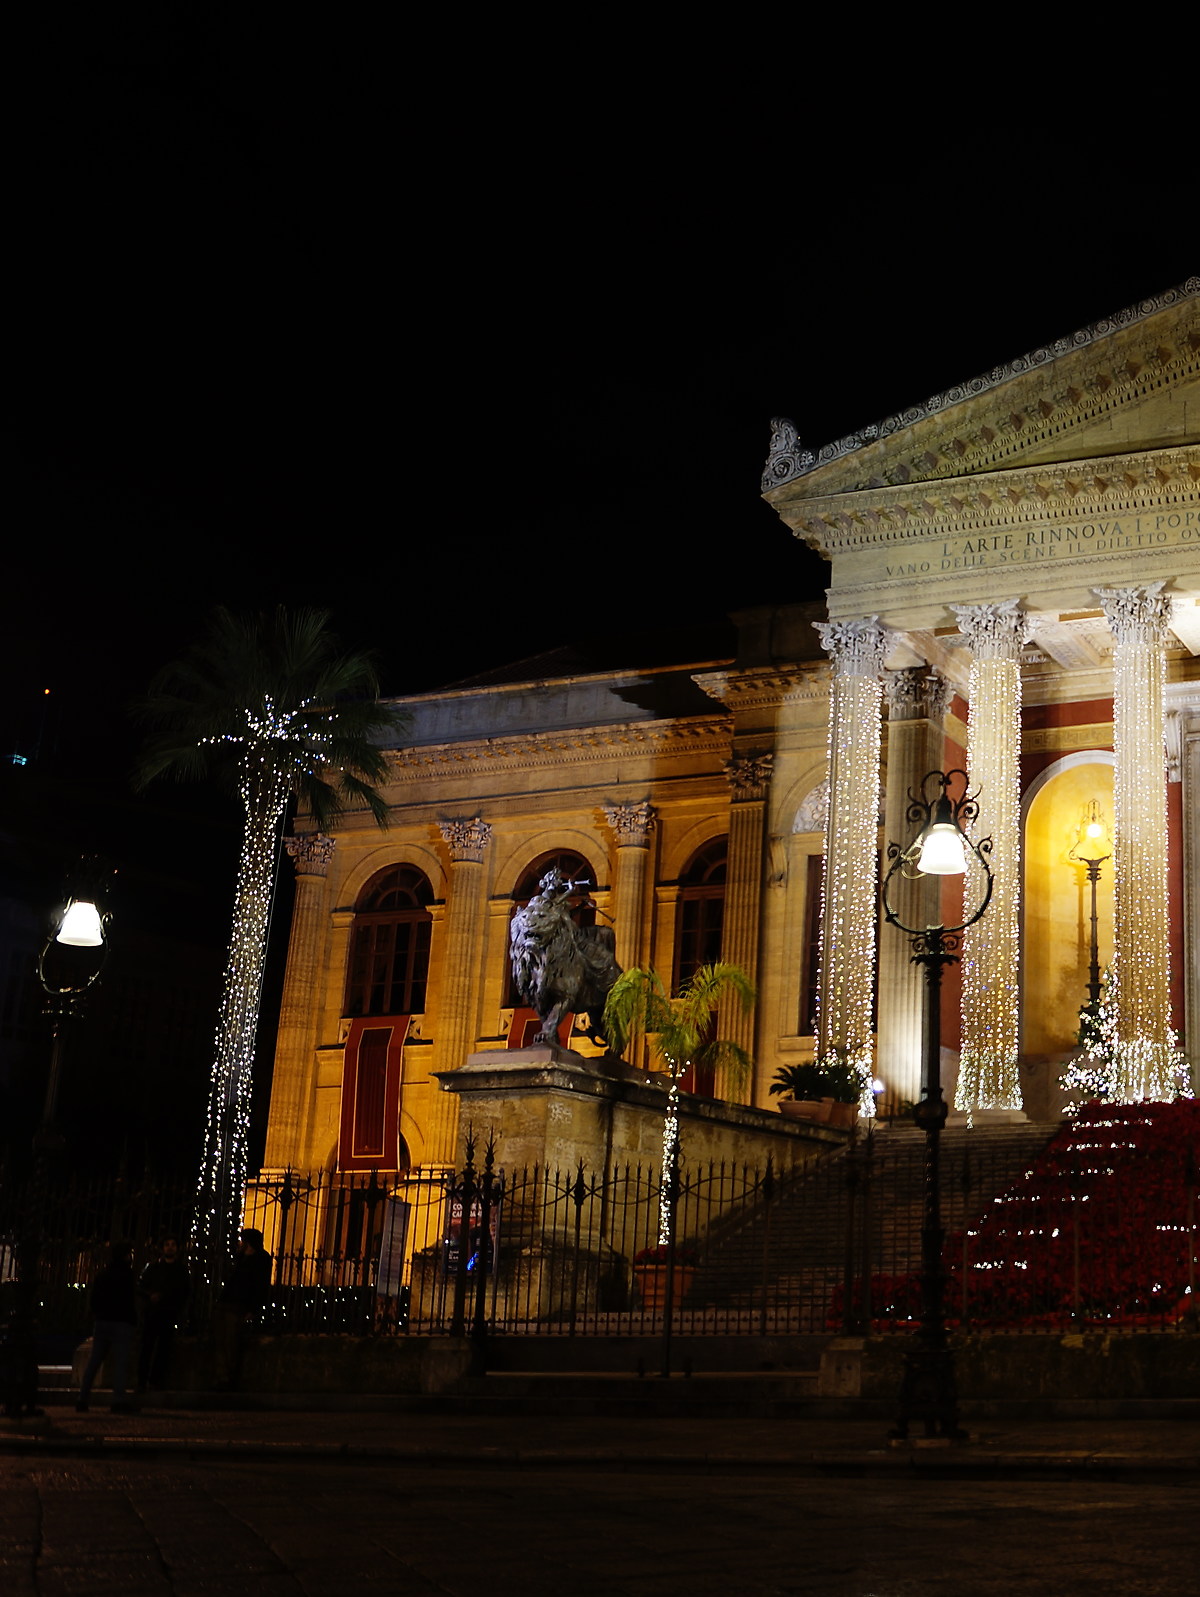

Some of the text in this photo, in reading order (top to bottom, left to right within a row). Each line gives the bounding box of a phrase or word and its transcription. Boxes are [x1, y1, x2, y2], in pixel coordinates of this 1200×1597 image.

[1026, 521, 1123, 546] RINNOVA
[1135, 518, 1141, 533] I
[886, 561, 930, 577] VANO
[941, 554, 987, 570] DELLE
[1000, 545, 1056, 563] SCENE
[1069, 543, 1085, 554] IL
[1096, 532, 1167, 550] DILETTO
